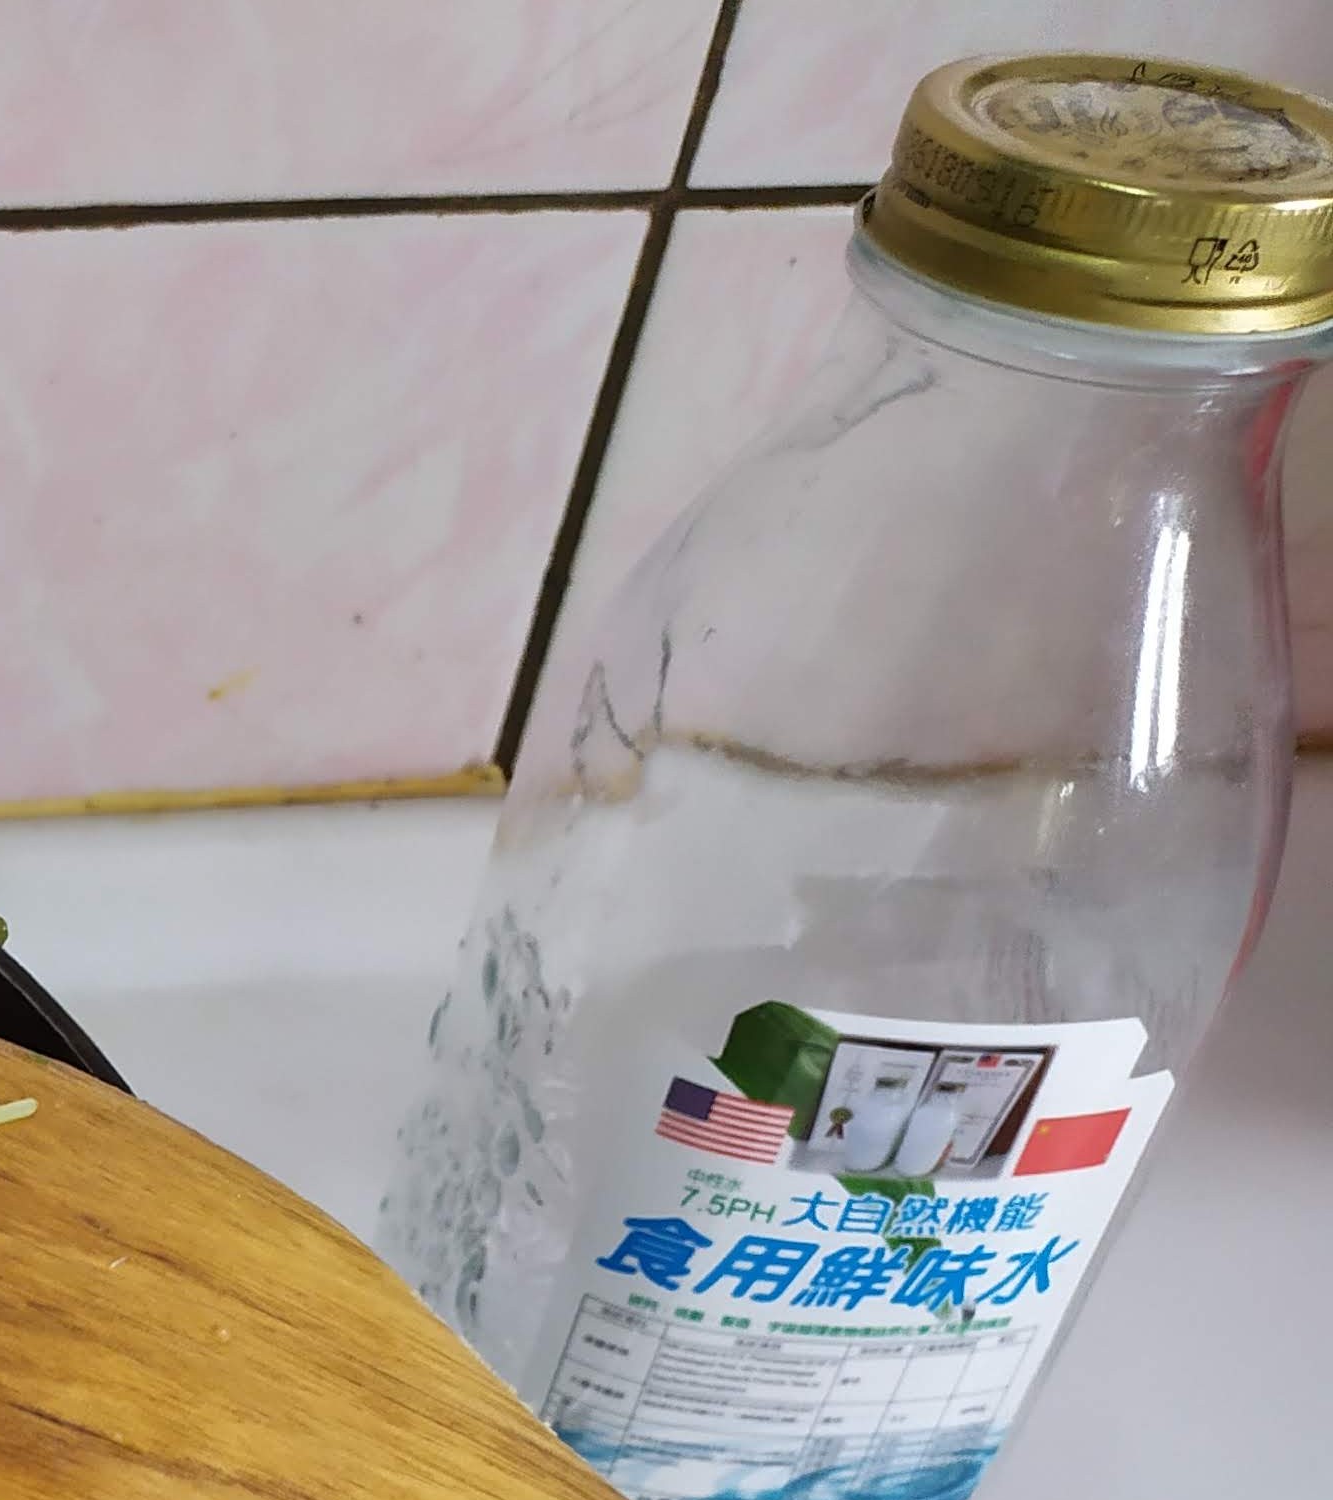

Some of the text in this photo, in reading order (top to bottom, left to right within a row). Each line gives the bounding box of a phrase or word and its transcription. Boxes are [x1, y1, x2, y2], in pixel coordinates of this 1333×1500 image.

[680, 1185, 777, 1224] 7.5PH
[781, 1191, 1050, 1236] 大自然機能
[595, 1216, 1080, 1312] 食用鮮味水
